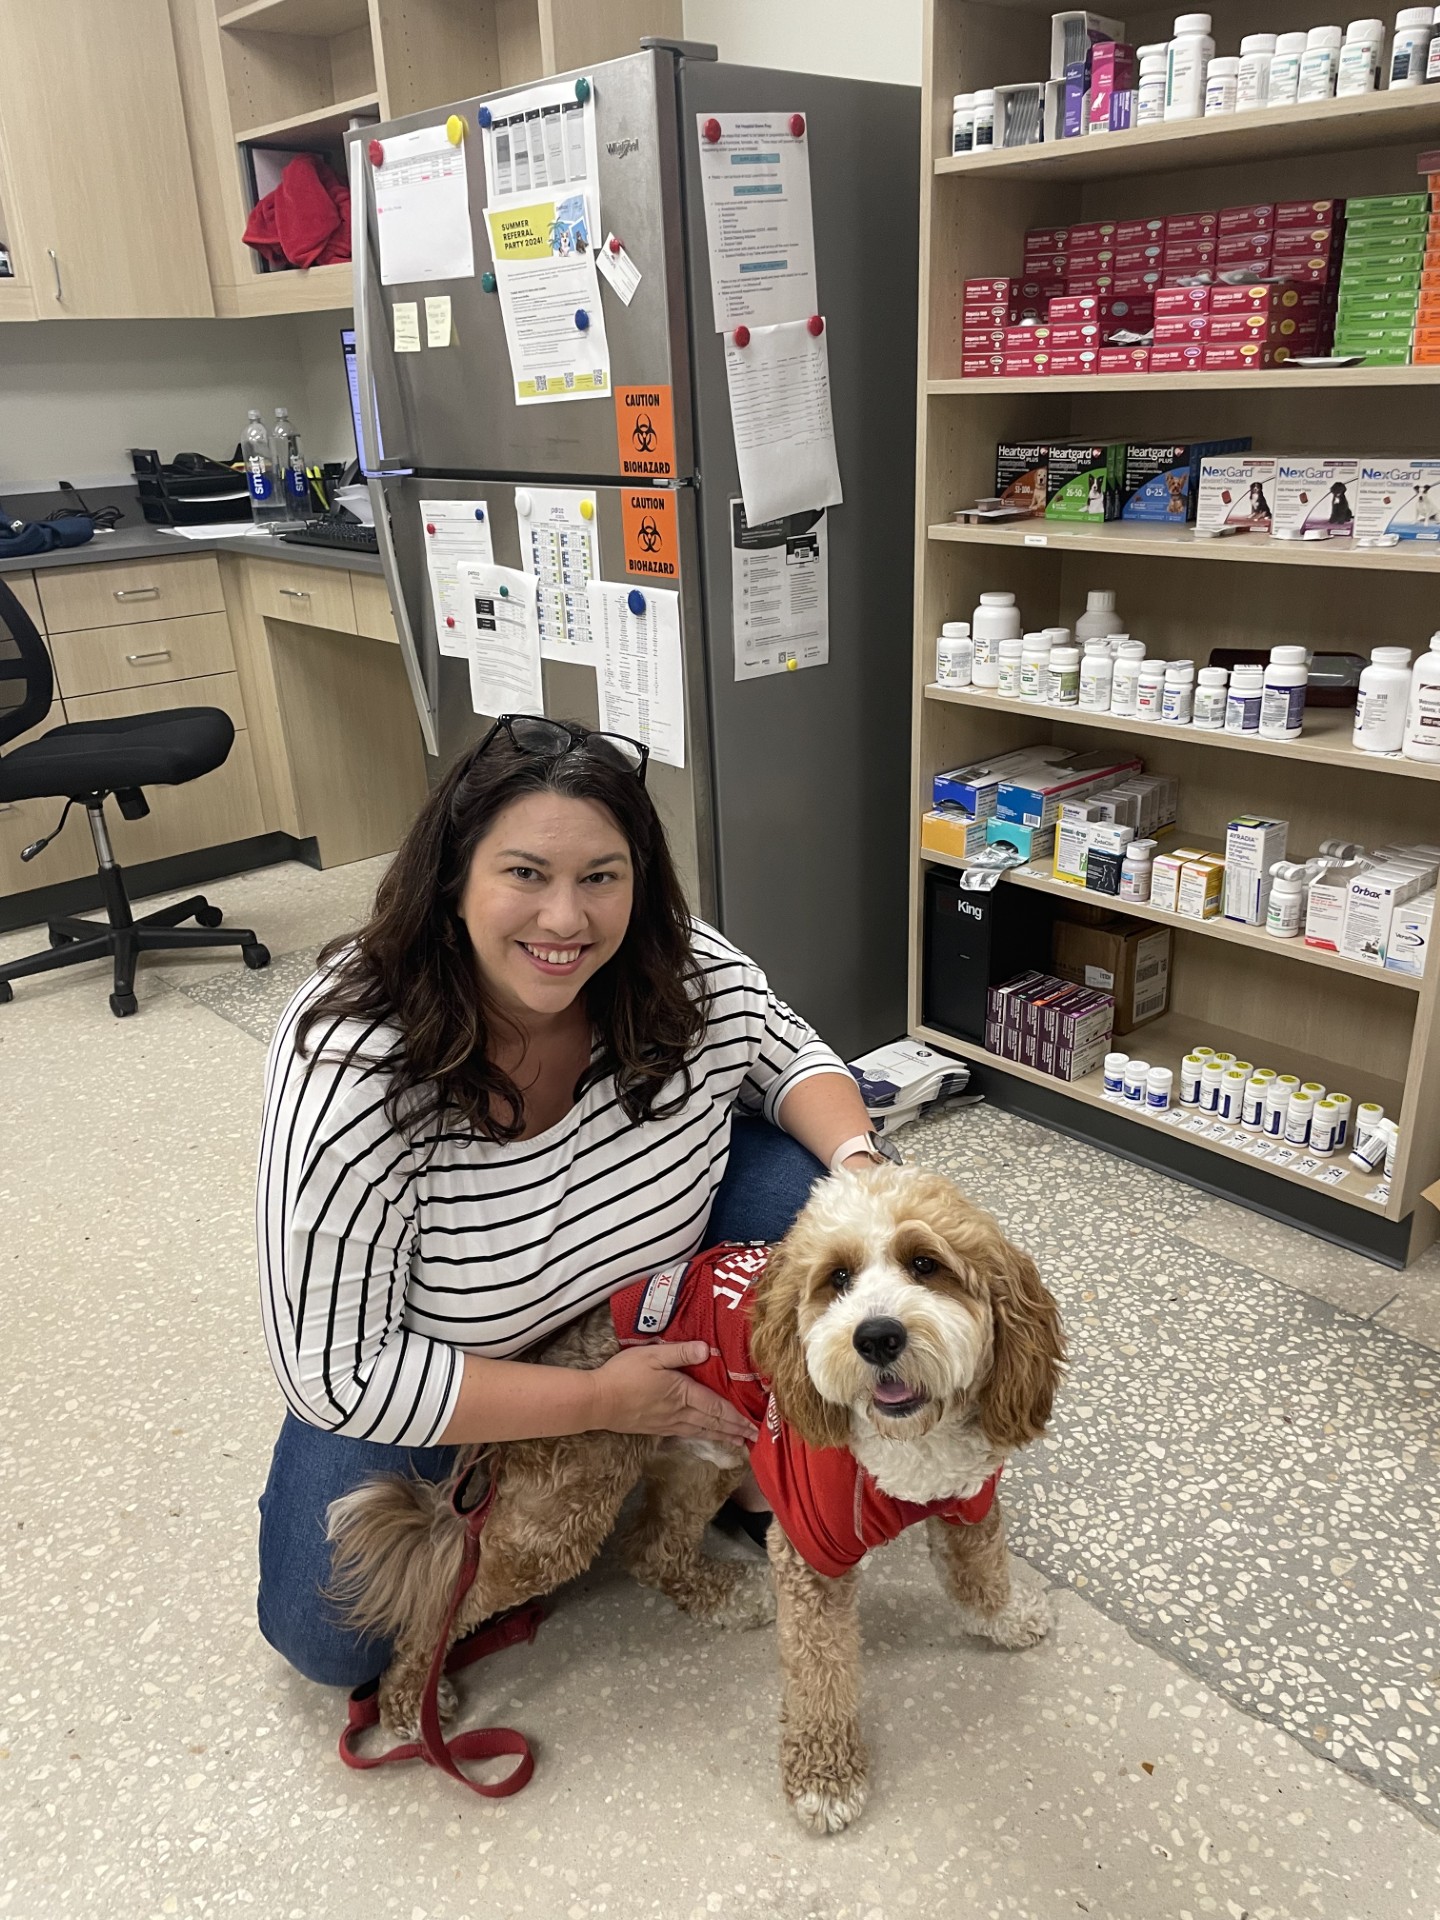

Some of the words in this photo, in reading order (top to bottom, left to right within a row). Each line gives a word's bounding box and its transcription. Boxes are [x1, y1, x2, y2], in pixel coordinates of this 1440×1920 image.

[502, 220, 528, 231] SUMMER
[504, 229, 534, 240] REFERRAL
[505, 241, 524, 250] PARTY
[525, 236, 544, 246] 2024!
[625, 394, 660, 406] CAUTION
[998, 446, 1040, 459] Heartgard
[1049, 448, 1092, 462] Heartgard
[1127, 446, 1174, 460] Heartgard
[624, 460, 671, 474] BIOHAZARD
[1202, 466, 1253, 477] NexGard
[1279, 467, 1334, 478] NexGard
[1362, 468, 1421, 480] NexGard
[249, 456, 264, 495] smart
[1146, 488, 1163, 497] 0-25
[631, 496, 665, 510] CAUTION
[629, 559, 674, 574] BIOHAZARD
[1352, 885, 1381, 899] Orbax
[958, 900, 982, 920] King
[657, 1274, 672, 1288] XL
